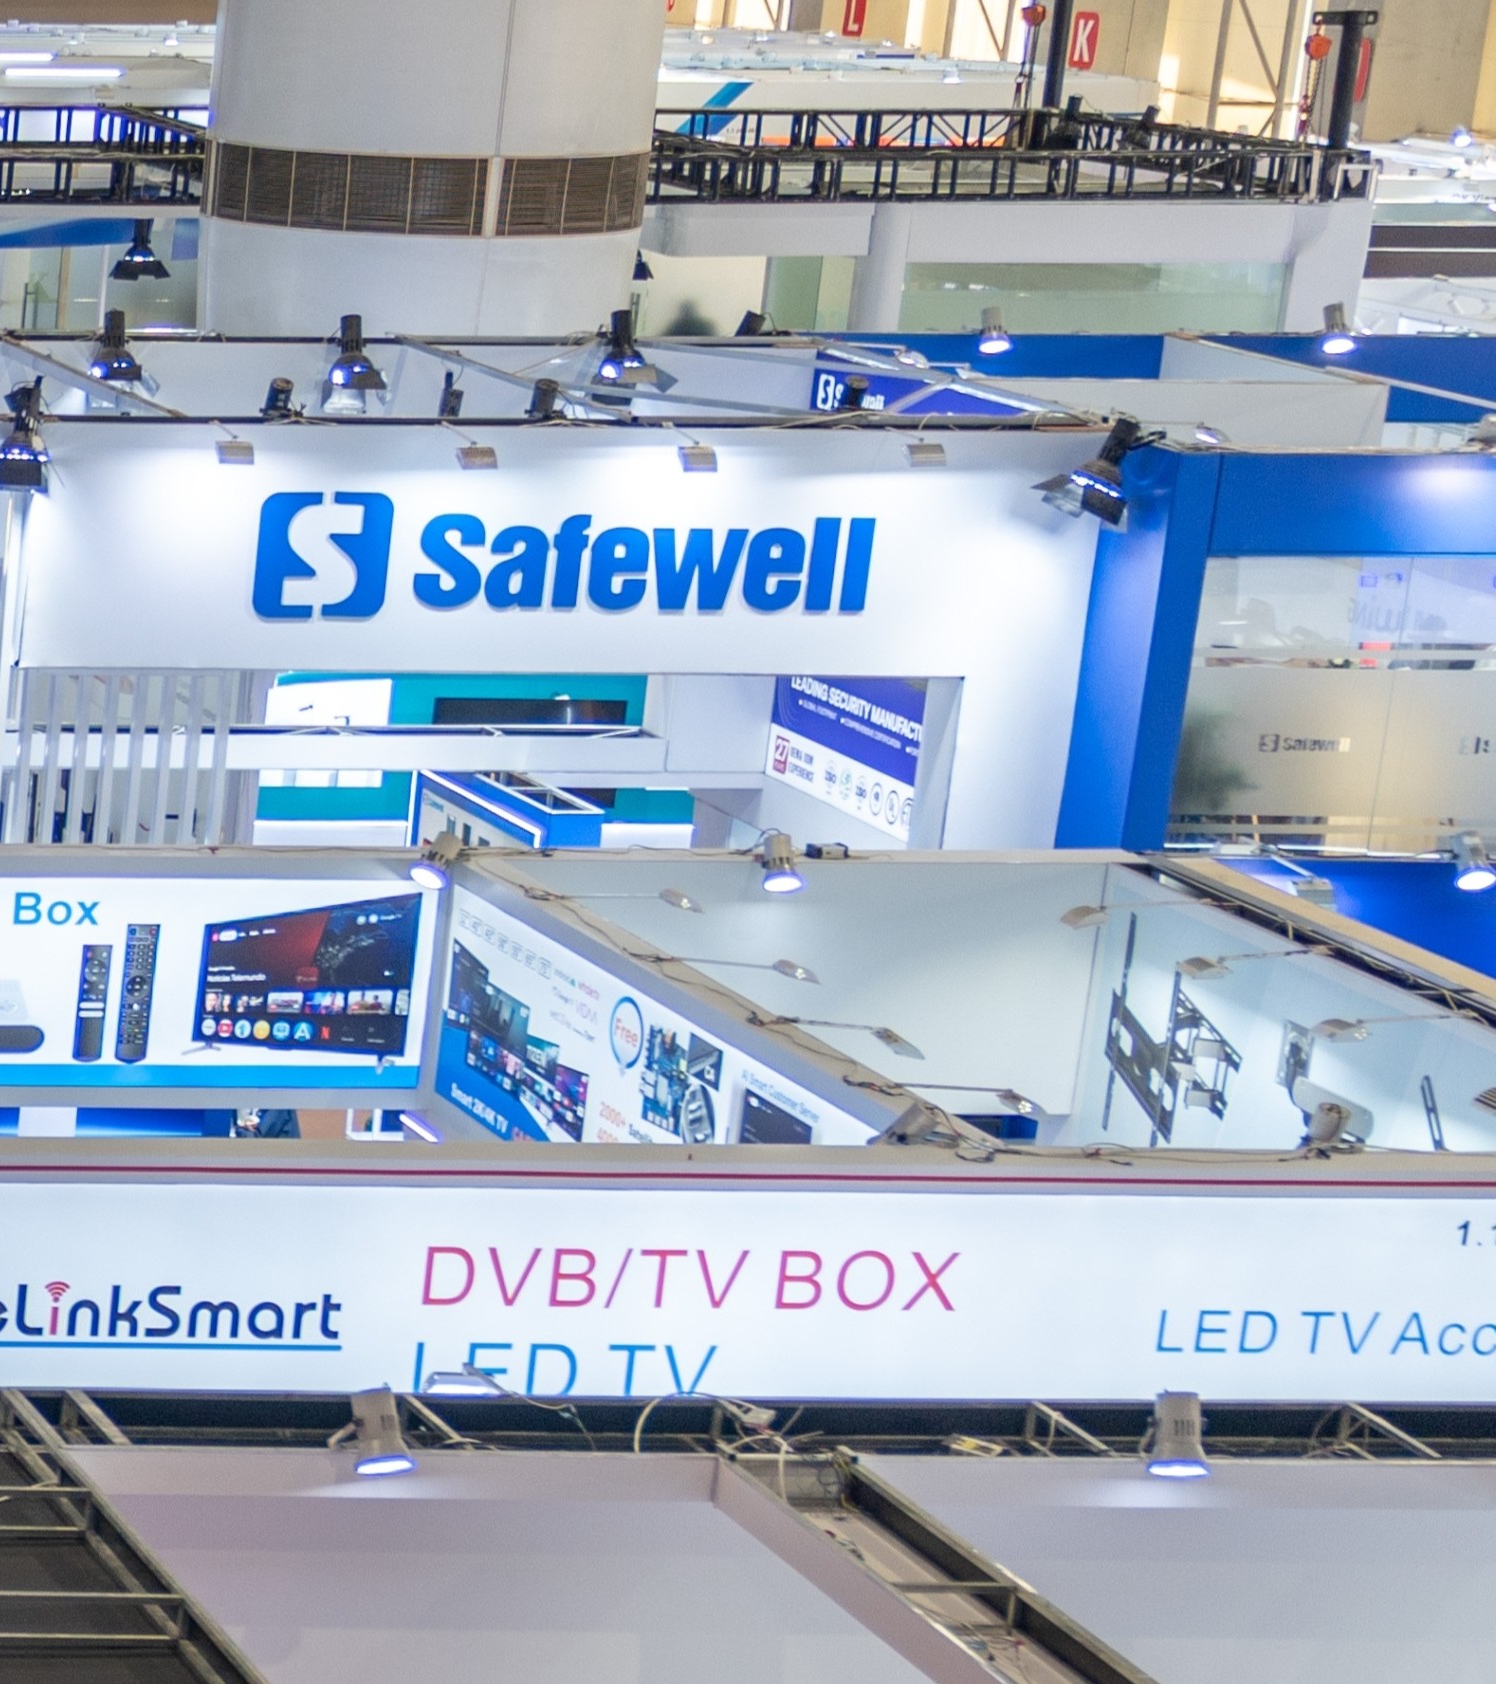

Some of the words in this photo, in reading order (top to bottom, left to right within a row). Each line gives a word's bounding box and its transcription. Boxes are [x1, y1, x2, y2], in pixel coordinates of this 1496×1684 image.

[1071, 14, 1095, 64] K
[411, 512, 878, 614] Safewell
[790, 676, 829, 702] LEADING
[828, 684, 873, 720] SECURITY
[12, 891, 102, 927] Box
[613, 1020, 639, 1050] Free
[420, 1245, 752, 1310] DVB/TV
[774, 1249, 963, 1313] BOX
[1155, 1307, 1282, 1356] LED
[1301, 1309, 1380, 1356] TV
[607, 1341, 720, 1400] TV
